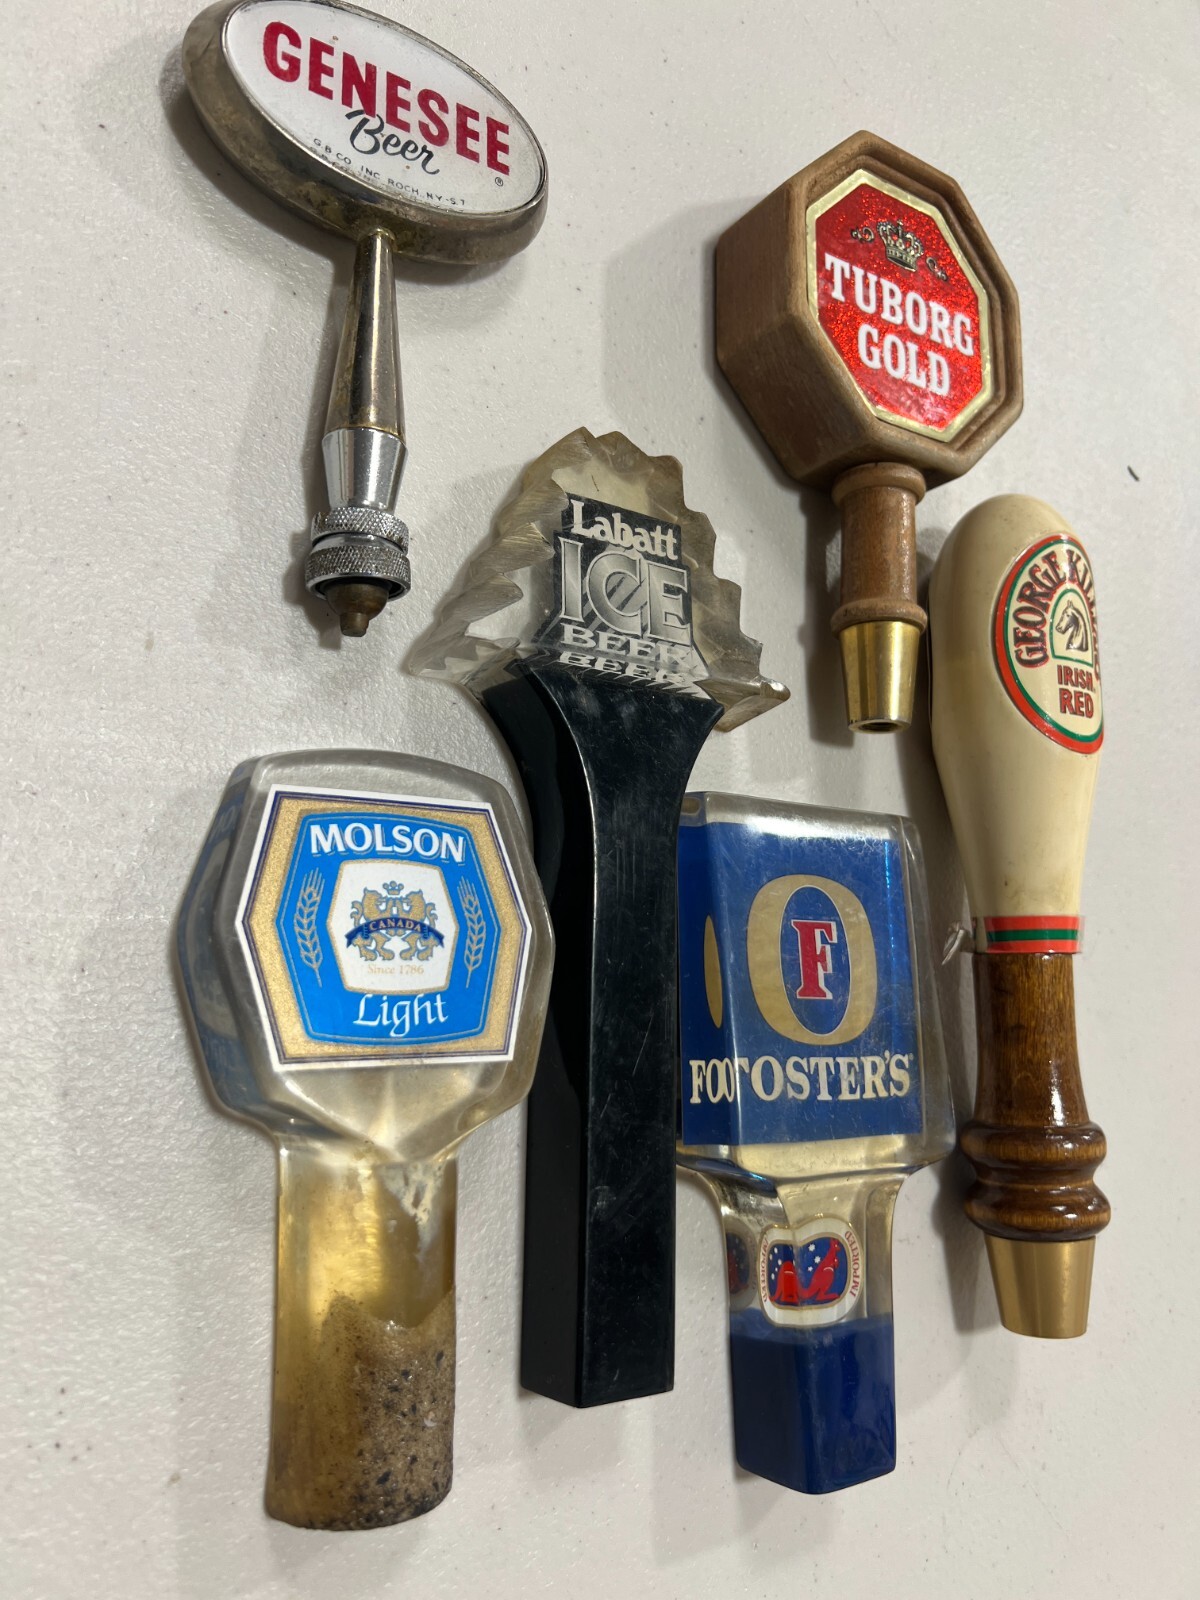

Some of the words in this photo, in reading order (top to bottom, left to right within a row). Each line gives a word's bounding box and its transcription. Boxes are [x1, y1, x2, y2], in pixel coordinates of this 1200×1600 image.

[263, 21, 510, 176] GENESEE
[345, 109, 440, 175] Beer
[824, 252, 975, 356] TUBORG
[857, 323, 951, 397] GOLD
[570, 498, 679, 561] Labatt
[558, 536, 692, 647] ICE
[1012, 549, 1067, 669] GEORGE
[559, 622, 692, 669] BEER
[1056, 664, 1094, 693] IRISH
[1058, 687, 1094, 719] RED
[309, 821, 467, 867] MOLSON
[369, 918, 422, 932] CANADA
[368, 963, 396, 975] Since
[400, 964, 425, 975] 1786
[791, 919, 838, 1000] F
[353, 993, 449, 1037] Light
[844, 1230, 861, 1298] IMPORTED
